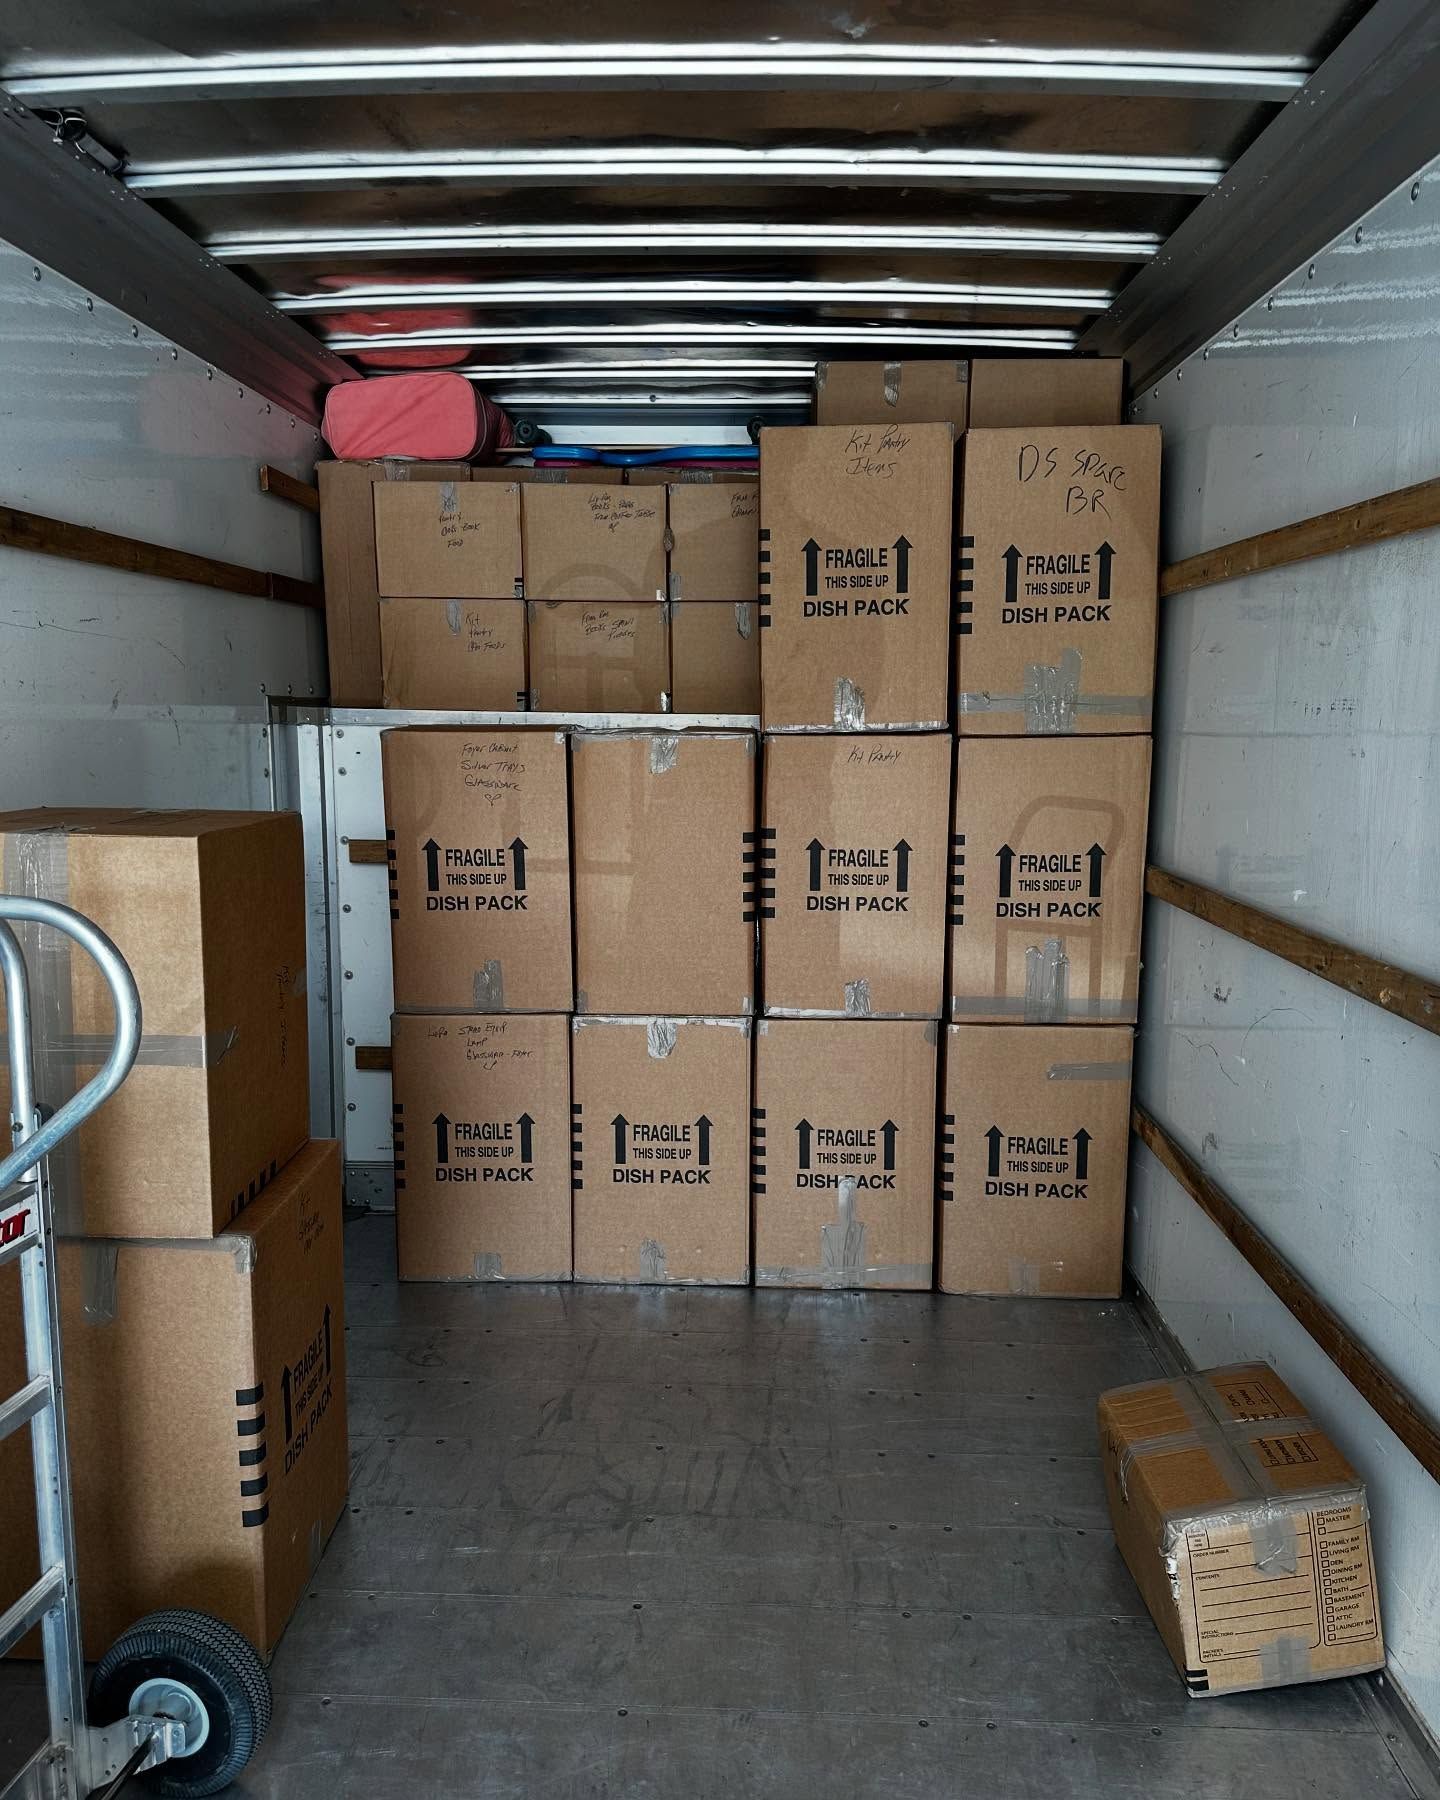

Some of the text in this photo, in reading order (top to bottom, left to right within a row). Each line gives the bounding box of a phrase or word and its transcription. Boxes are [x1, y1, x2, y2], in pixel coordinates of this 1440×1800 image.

[845, 430, 872, 453] Kit
[846, 457, 897, 479] Items
[1019, 444, 1059, 483] DS
[1066, 486, 1112, 520] BR
[825, 547, 888, 569] FRAGILE
[1026, 553, 1090, 576] FRAGILE
[825, 575, 889, 588] THIS SIDE UP
[1025, 581, 1091, 596] THIS SIDE UP
[804, 599, 910, 617] DISH PACK
[1002, 605, 1112, 623] DISH PACK
[461, 743, 487, 757] Foyer
[460, 760, 493, 770] Silver
[446, 848, 506, 867] FRAGILE
[829, 849, 888, 868] FRAGILE
[1019, 854, 1082, 873] FRAGILE
[446, 874, 507, 886] THIS SIDE UP
[828, 874, 889, 886] THIS SIDE UP
[1018, 880, 1082, 892] THIS SIDE UP
[426, 895, 528, 912] DISH PACK
[807, 896, 909, 912] DISH PACK
[996, 902, 1103, 918] DISH PACK
[455, 1122, 513, 1141] FRAGILE
[633, 1124, 691, 1142] FRAGILE
[817, 1129, 876, 1147] FRAGILE
[455, 1147, 514, 1158] THIS SIDE UP
[633, 1148, 692, 1160] THIS SIDE UP
[1008, 1136, 1068, 1156] FRAGILE
[817, 1153, 877, 1165] THIS SIDE UP
[435, 1167, 534, 1183] DISH PACK
[1007, 1161, 1069, 1174] THIS SIDE UP
[613, 1168, 712, 1184] DISH PACK
[796, 1173, 897, 1189] DISH ACK
[985, 1181, 1088, 1199] DISH PACK
[293, 1329, 324, 1394] FRAGILE
[285, 1379, 332, 1475] DISH PACK
[1316, 1506, 1352, 1517] BEDROOMS
[1326, 1514, 1351, 1524] MASTER
[1328, 1535, 1360, 1548] FAMILY RM
[1329, 1545, 1360, 1556] LIVING RM
[1330, 1559, 1344, 1567] DEN
[1331, 1563, 1363, 1576] DINING RM
[1195, 1573, 1220, 1581] CONTENTS
[1331, 1574, 1358, 1585] KITCHEN
[1333, 1586, 1349, 1594] BATH
[1334, 1591, 1366, 1603] BASEMENT
[1336, 1613, 1353, 1621] ATTIC
[1336, 1618, 1374, 1631] LAUNDRY RM
